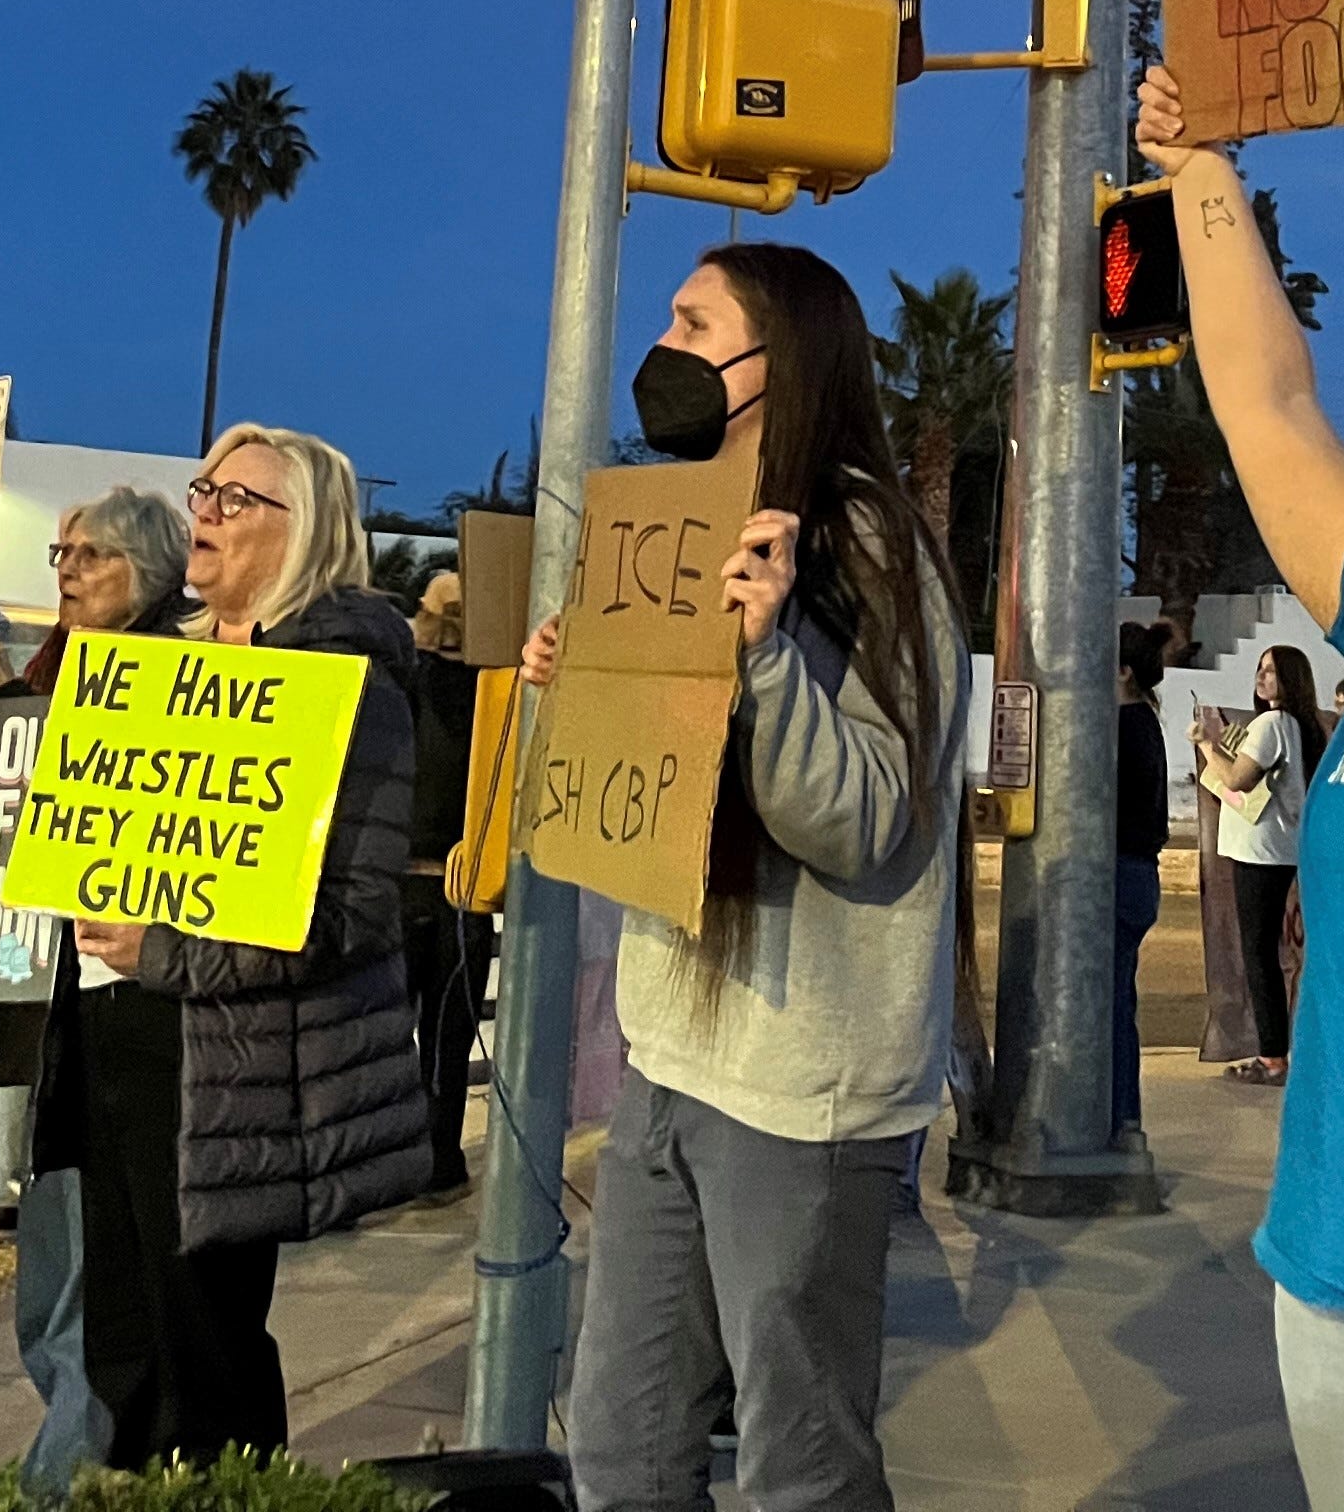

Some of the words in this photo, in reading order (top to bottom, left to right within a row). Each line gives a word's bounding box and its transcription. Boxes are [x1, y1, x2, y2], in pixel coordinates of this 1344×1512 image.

[601, 517, 711, 617] ICE
[74, 642, 140, 712] WE
[166, 653, 285, 724] HAVE
[58, 733, 292, 813] WHISTLES
[532, 755, 585, 834] SH
[600, 753, 678, 844] CBP
[29, 792, 135, 848] THEY
[147, 812, 264, 868] HAVE
[77, 858, 218, 928] GUNS
